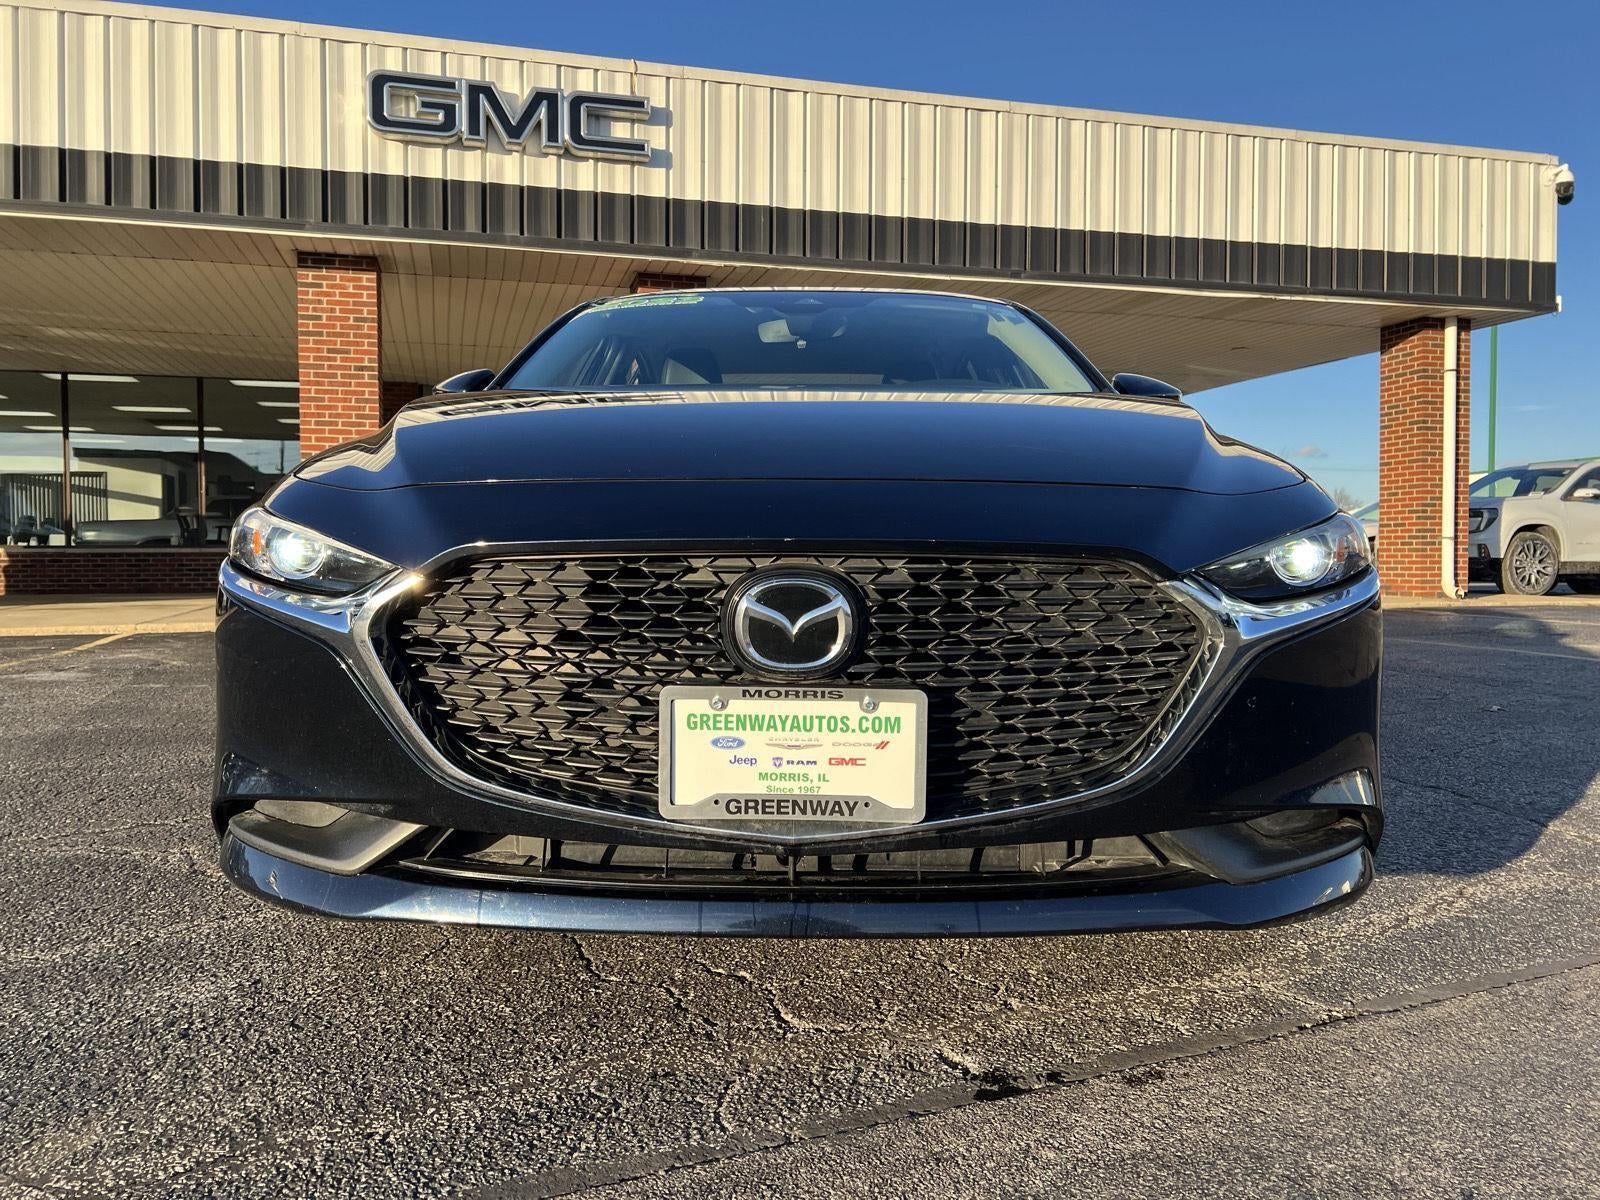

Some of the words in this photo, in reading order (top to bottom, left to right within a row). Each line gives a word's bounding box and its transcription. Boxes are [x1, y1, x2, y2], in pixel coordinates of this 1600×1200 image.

[368, 69, 650, 162] GMC
[741, 689, 844, 699] MORRIS
[686, 713, 901, 734] GREENWAYAUTOS.COM
[729, 754, 758, 766] Jeep
[828, 757, 867, 767] GMC
[758, 772, 813, 784] MORRIS,
[818, 773, 830, 782] IL
[766, 785, 794, 794] Since
[797, 785, 822, 794] 1967
[725, 798, 858, 817] GREENWAY
